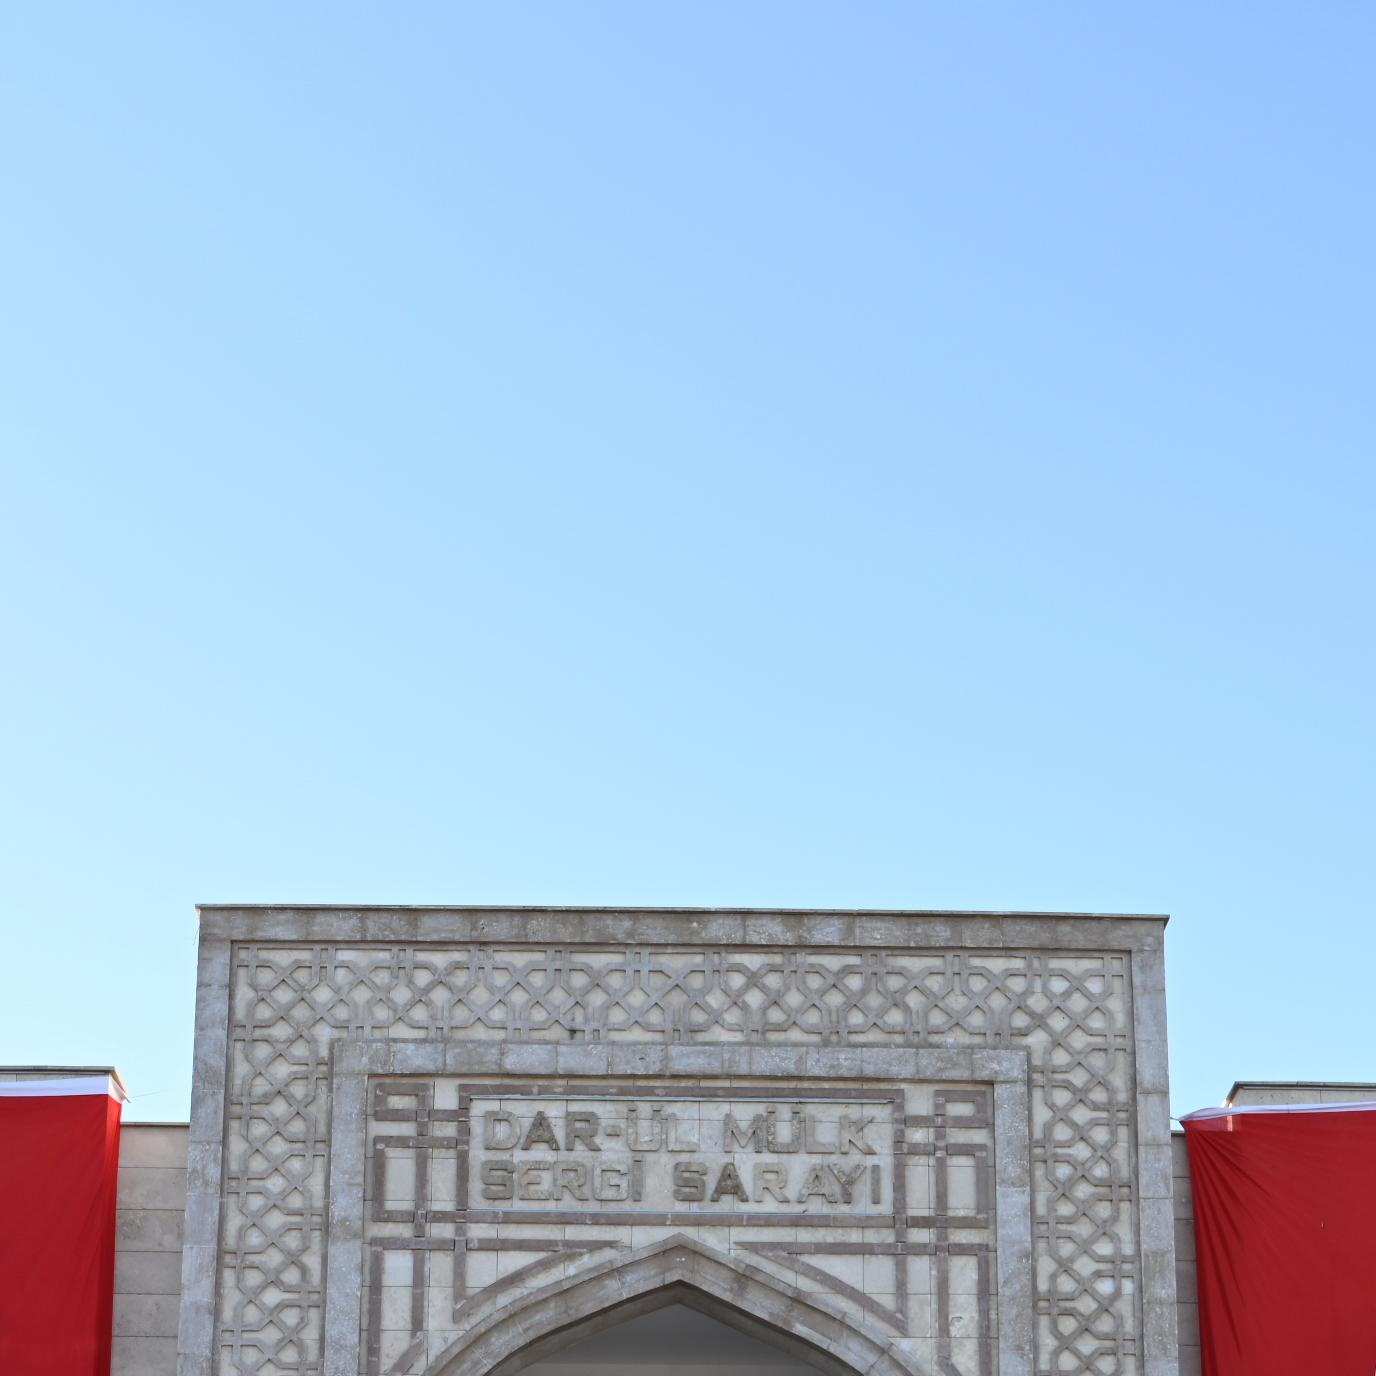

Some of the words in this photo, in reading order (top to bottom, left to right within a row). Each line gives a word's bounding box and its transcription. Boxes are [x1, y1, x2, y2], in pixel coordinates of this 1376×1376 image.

[483, 1104, 700, 1152] DAR-ÜL
[724, 1104, 877, 1156] MÜLK
[480, 1155, 643, 1201] SERGİ
[672, 1162, 881, 1205] SARAYI
